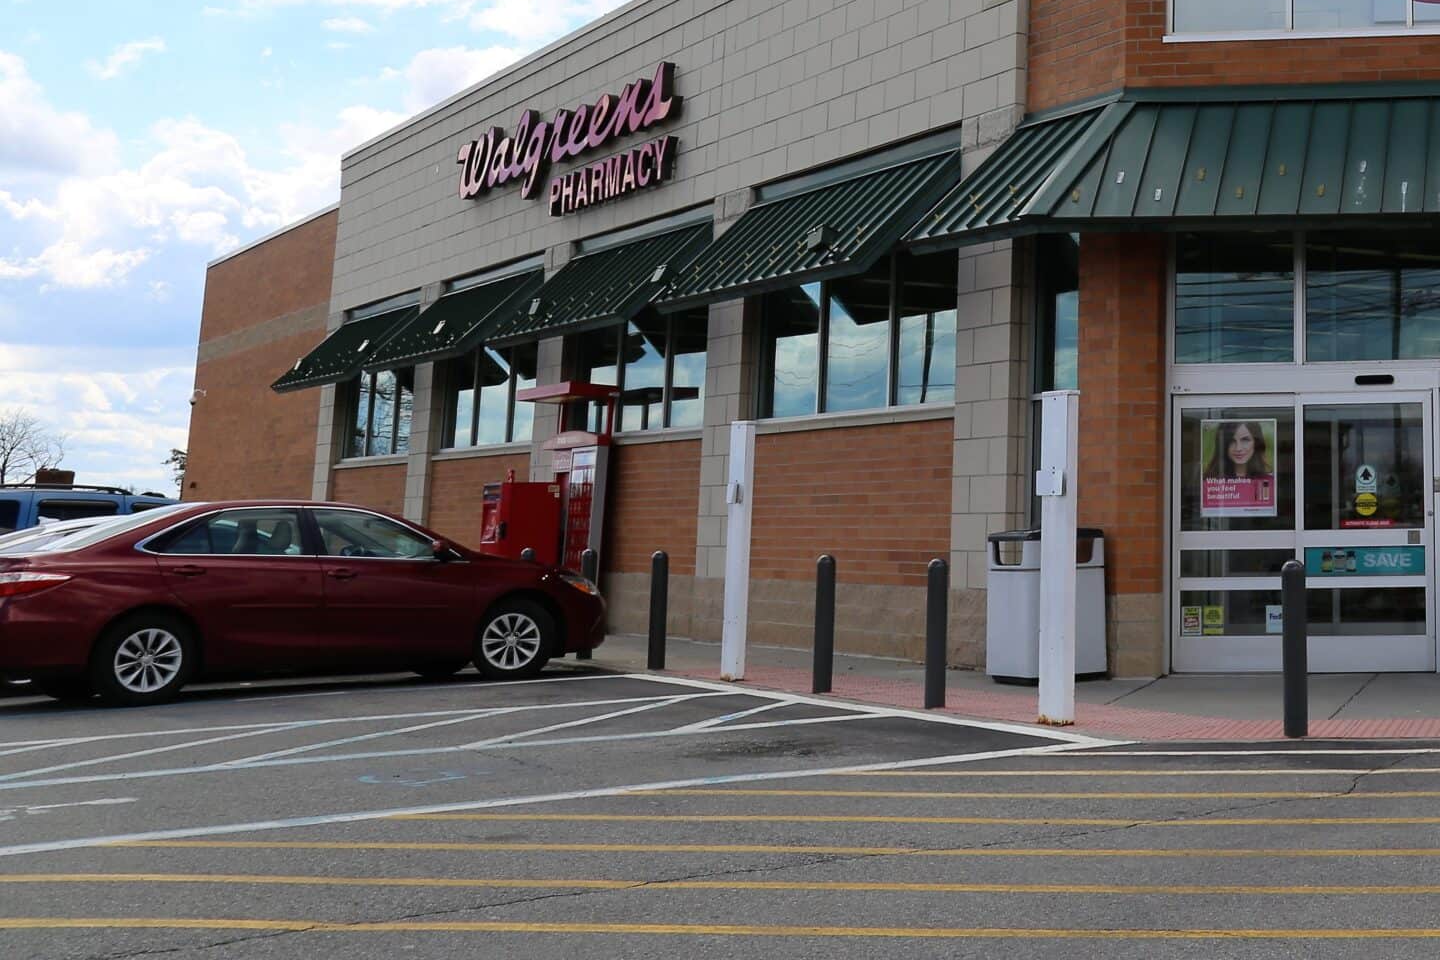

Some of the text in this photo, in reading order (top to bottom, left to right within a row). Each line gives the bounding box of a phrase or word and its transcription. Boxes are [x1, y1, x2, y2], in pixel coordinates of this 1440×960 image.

[457, 61, 680, 200] Walgreens
[549, 136, 675, 216] PHARMACY
[1207, 492, 1240, 500] beautiful
[1221, 484, 1236, 492] feel
[1363, 552, 1412, 568] SAVE
